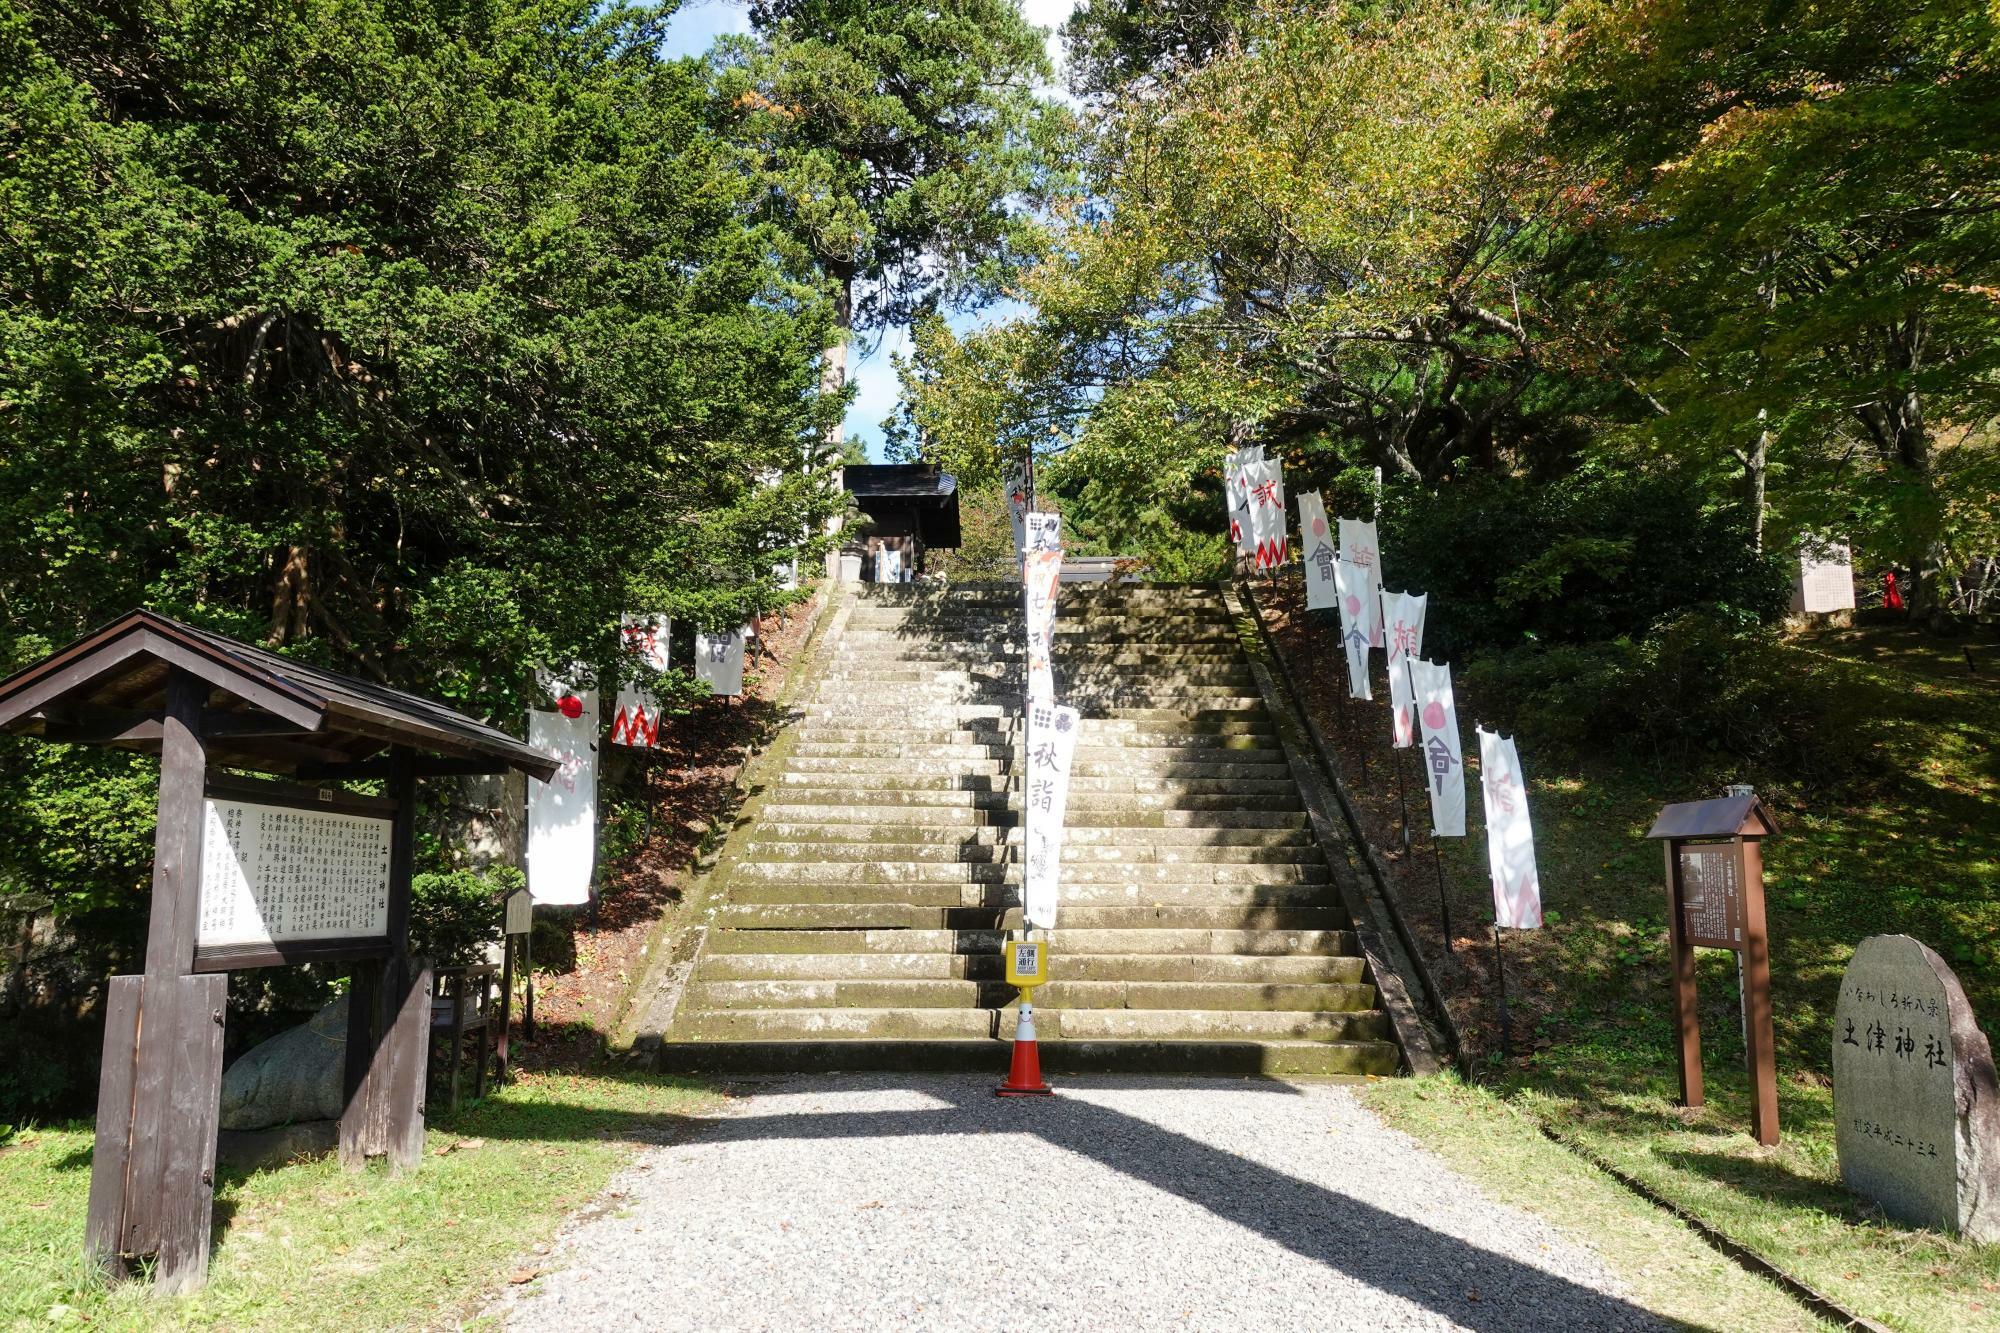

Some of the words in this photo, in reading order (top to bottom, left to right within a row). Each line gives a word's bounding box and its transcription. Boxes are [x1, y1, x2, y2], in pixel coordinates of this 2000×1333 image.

[1252, 479, 1282, 509] 誠
[1031, 740, 1061, 815] 秋詣
[378, 844, 388, 910] 土津神社
[1018, 949, 1035, 958] 左側
[1018, 957, 1035, 966] 通行
[1842, 1017, 1948, 1070] 土津神社
